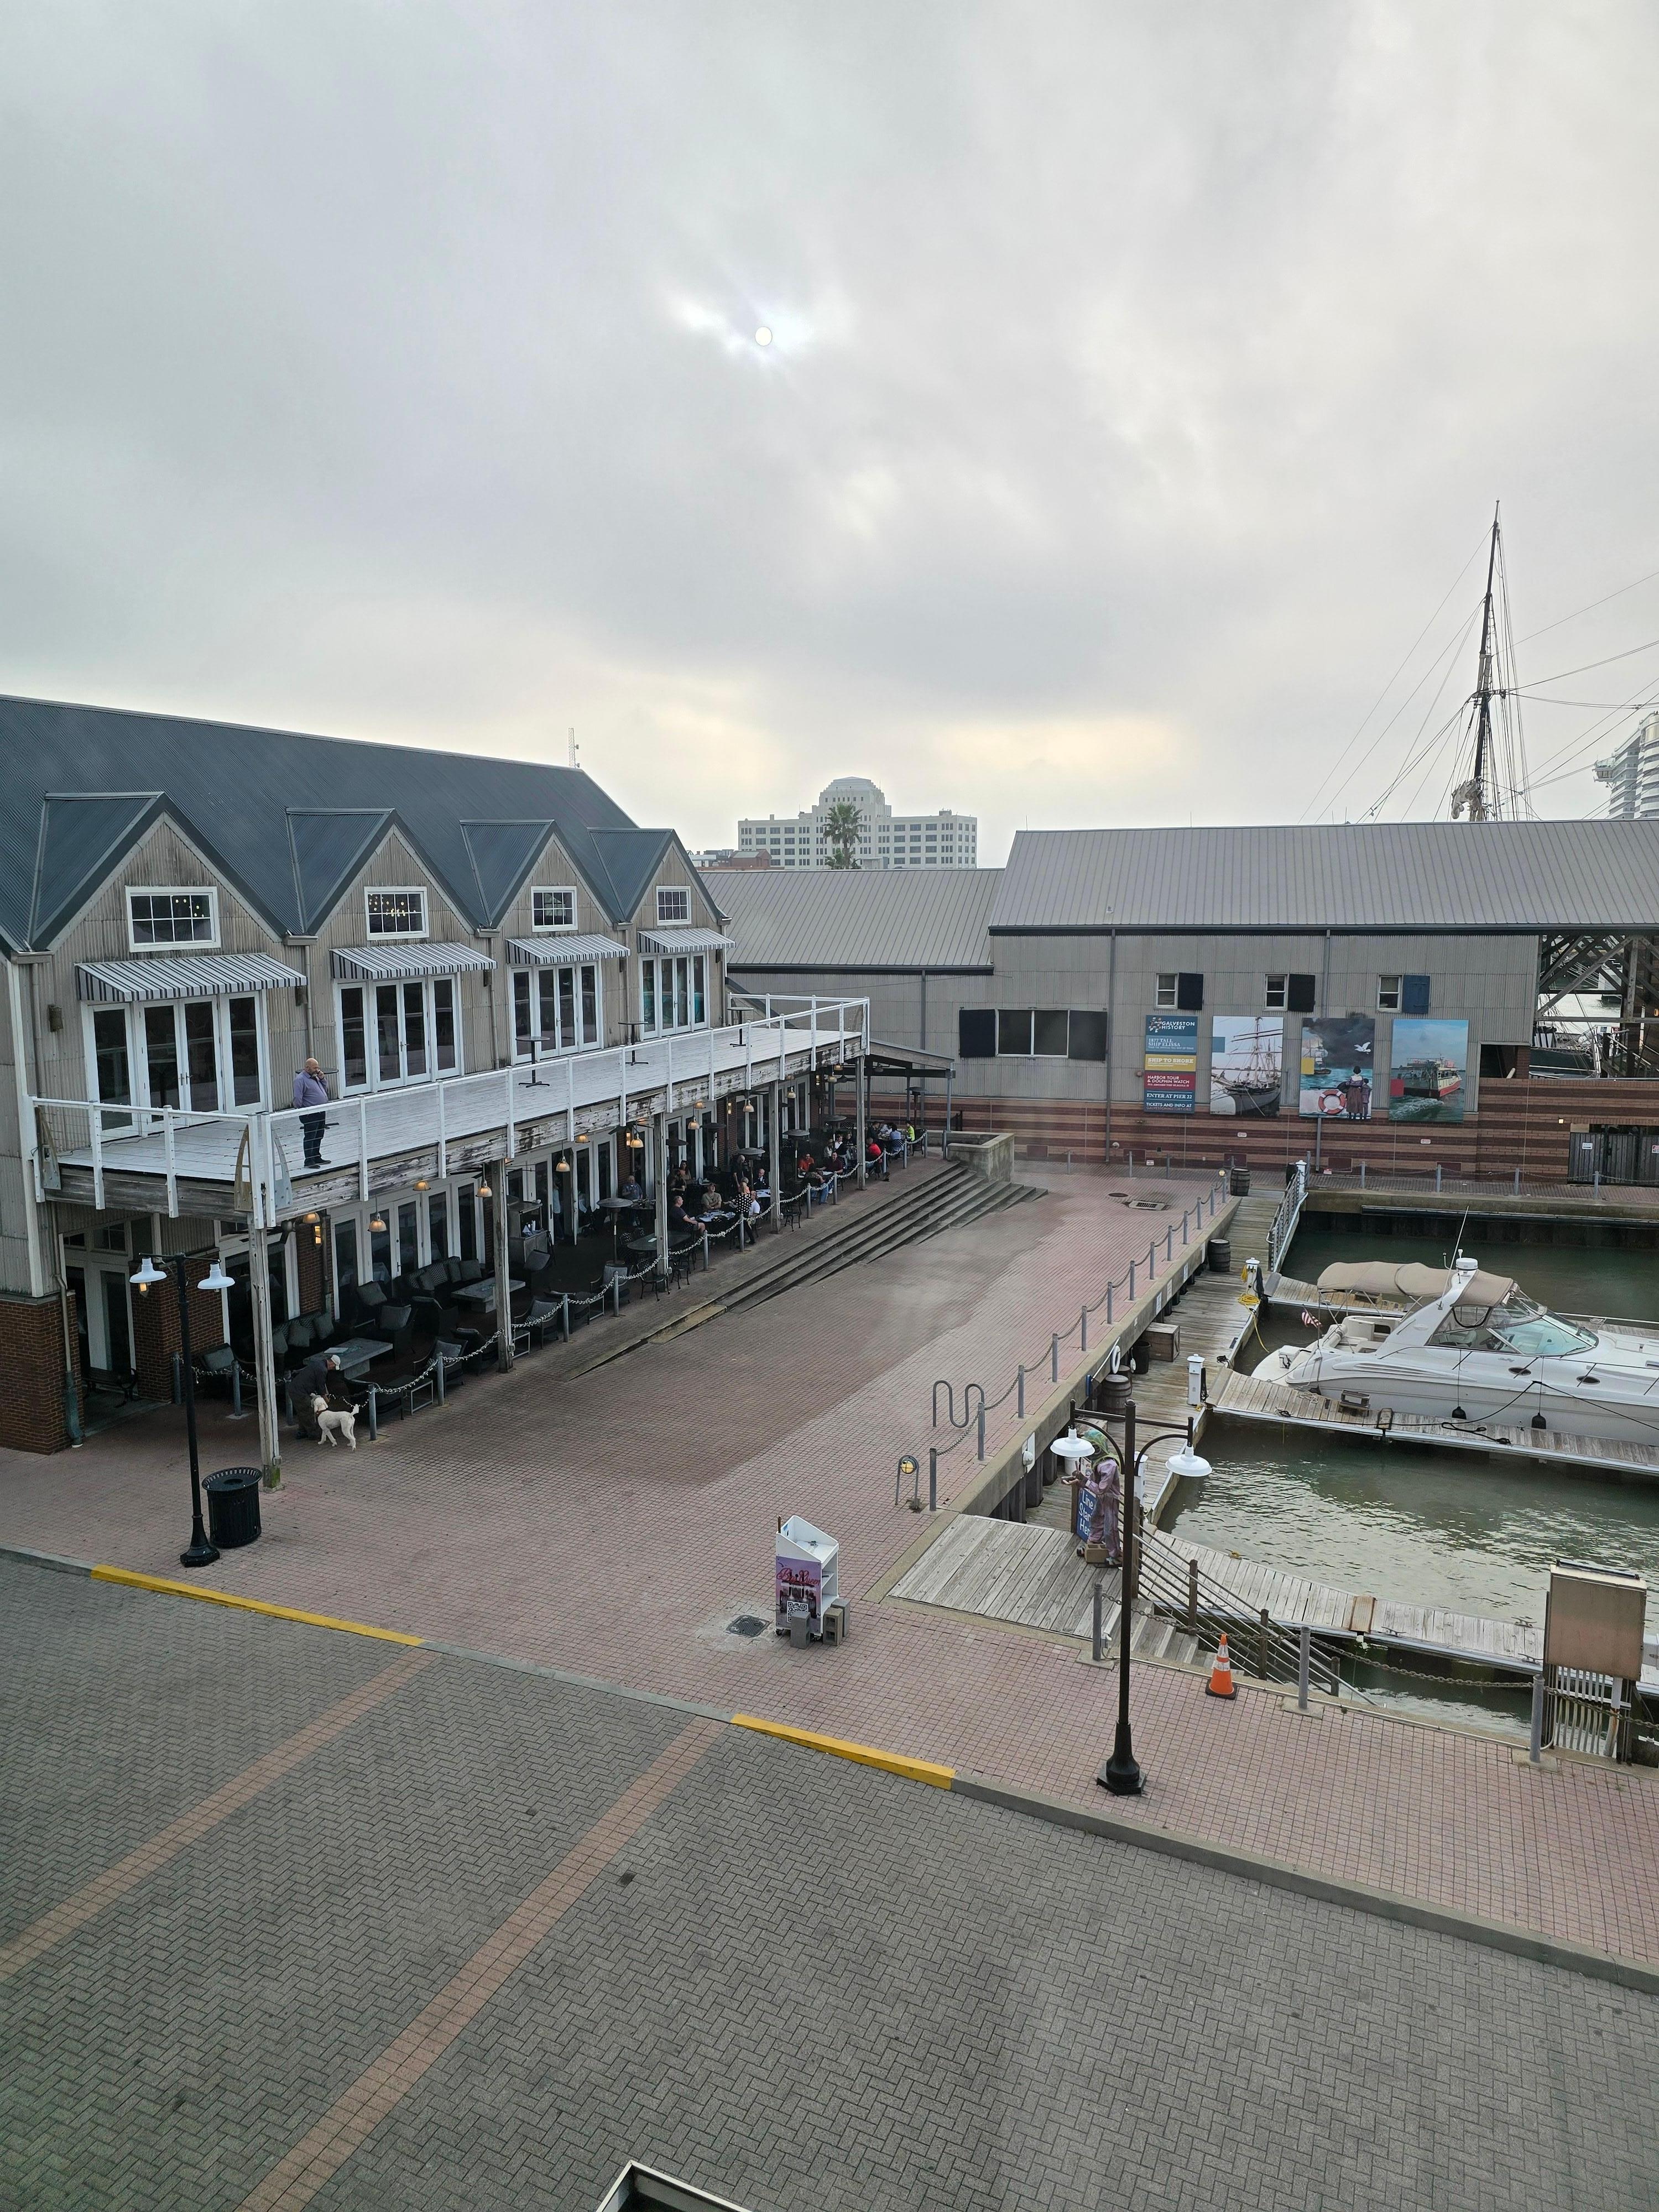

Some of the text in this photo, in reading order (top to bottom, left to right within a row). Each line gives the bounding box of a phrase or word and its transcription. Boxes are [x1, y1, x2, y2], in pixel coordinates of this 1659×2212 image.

[1082, 1490, 1093, 1510] Line
[1079, 1503, 1091, 1521] Star
[1080, 1518, 1091, 1536] Her
